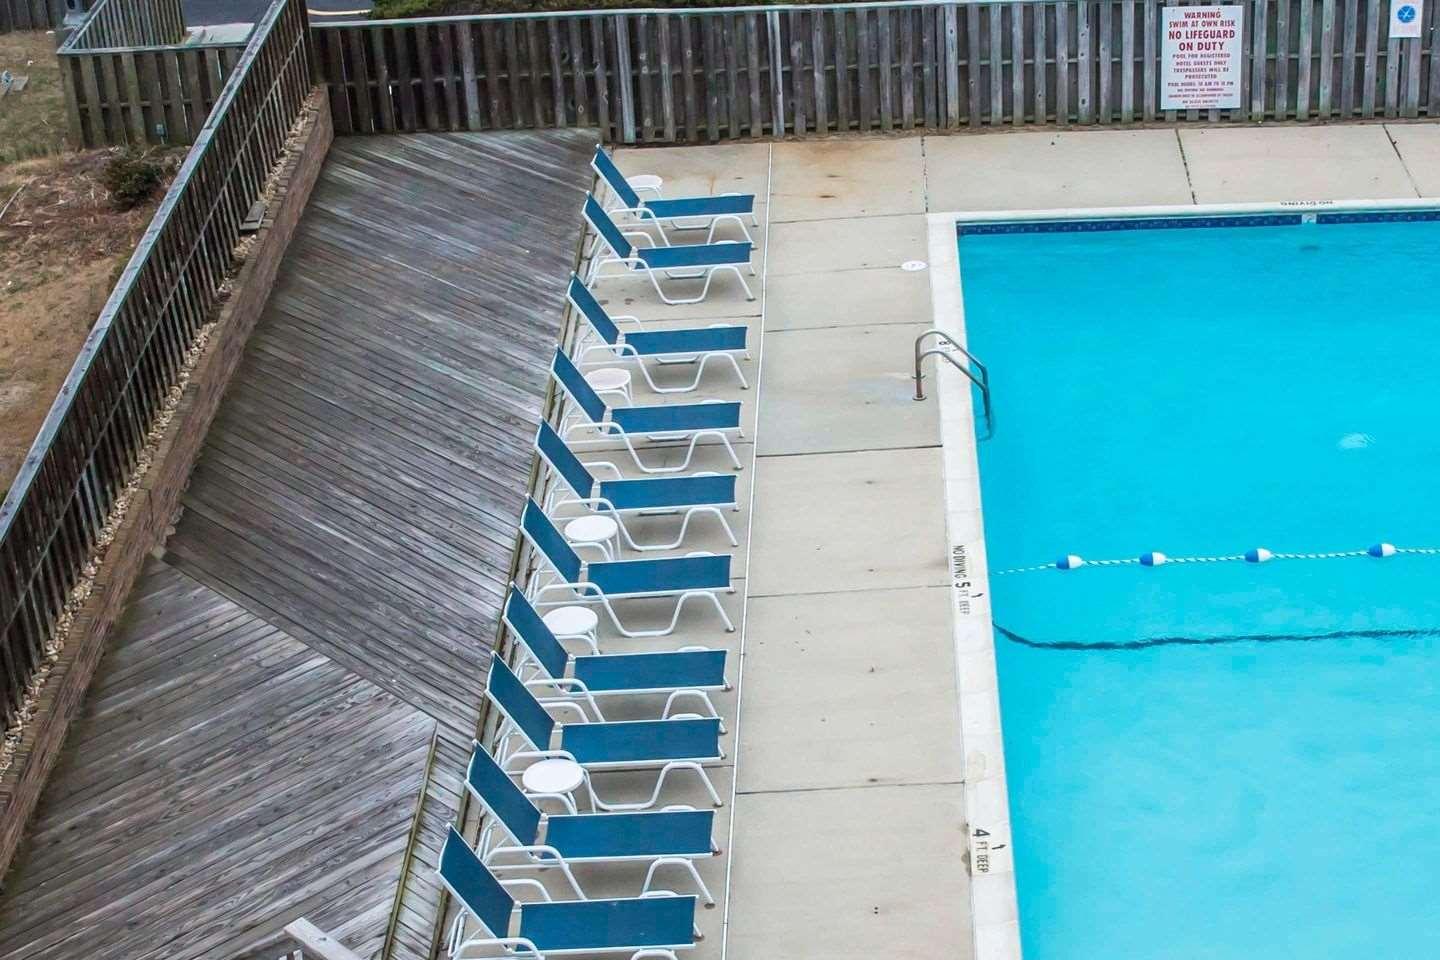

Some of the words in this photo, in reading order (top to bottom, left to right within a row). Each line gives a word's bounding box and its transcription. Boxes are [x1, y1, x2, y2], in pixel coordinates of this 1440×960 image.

[1184, 11, 1221, 19] WARNING
[1168, 31, 1182, 40] NO
[1185, 30, 1235, 39] LIFEGUARD
[1178, 42, 1193, 51] ON
[1197, 41, 1224, 51] DUTY
[952, 555, 968, 579] DIVING
[954, 581, 971, 589] 5
[972, 828, 991, 837] 4
[976, 854, 990, 873] DEEP
